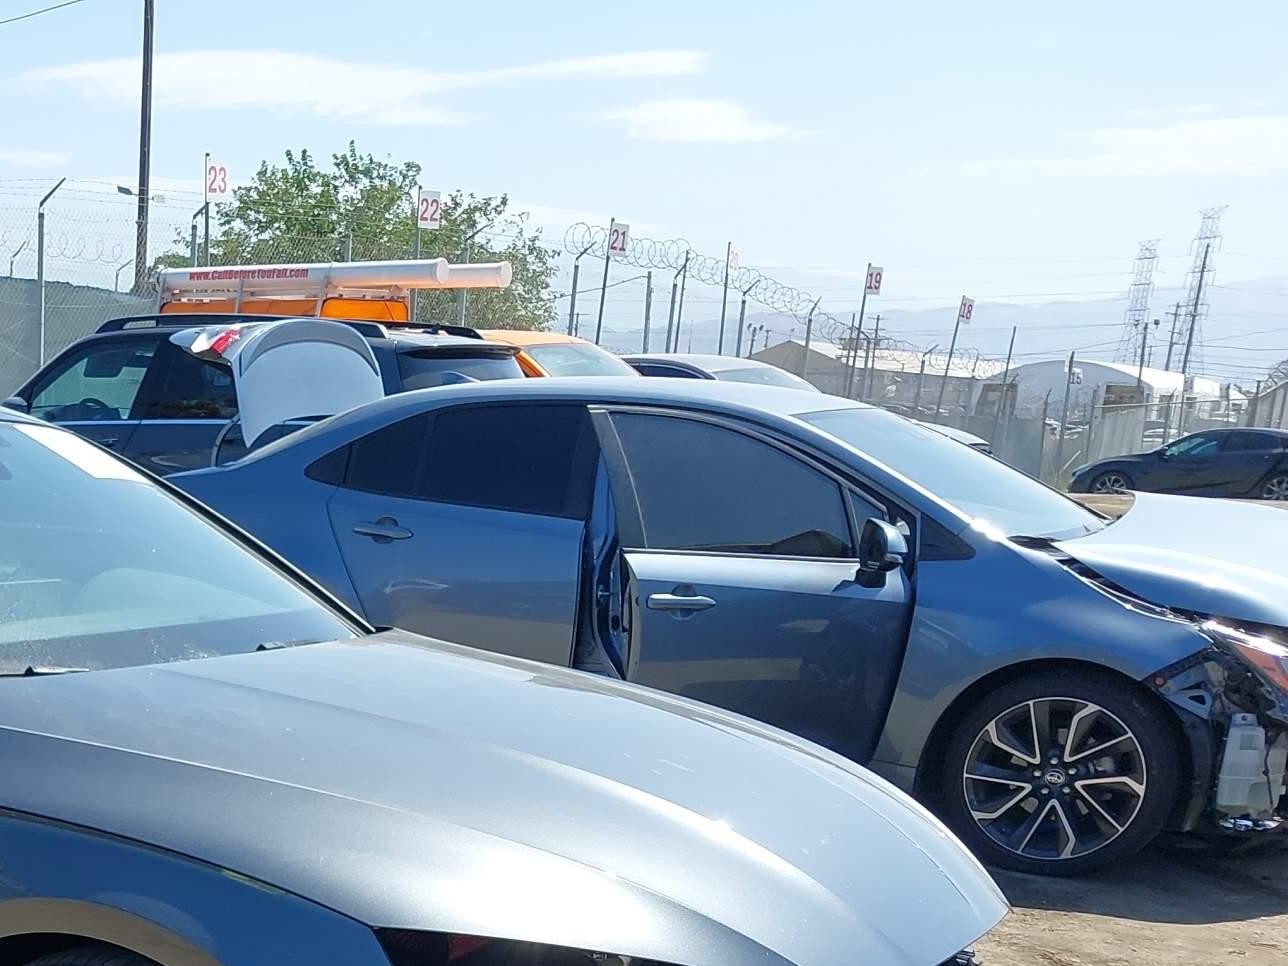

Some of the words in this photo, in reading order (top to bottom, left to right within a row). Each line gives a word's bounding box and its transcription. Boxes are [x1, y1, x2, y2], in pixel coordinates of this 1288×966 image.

[208, 165, 227, 193] 23
[419, 198, 439, 222] 22
[610, 229, 626, 251] 21
[867, 271, 882, 290] 19
[960, 303, 973, 320] 18
